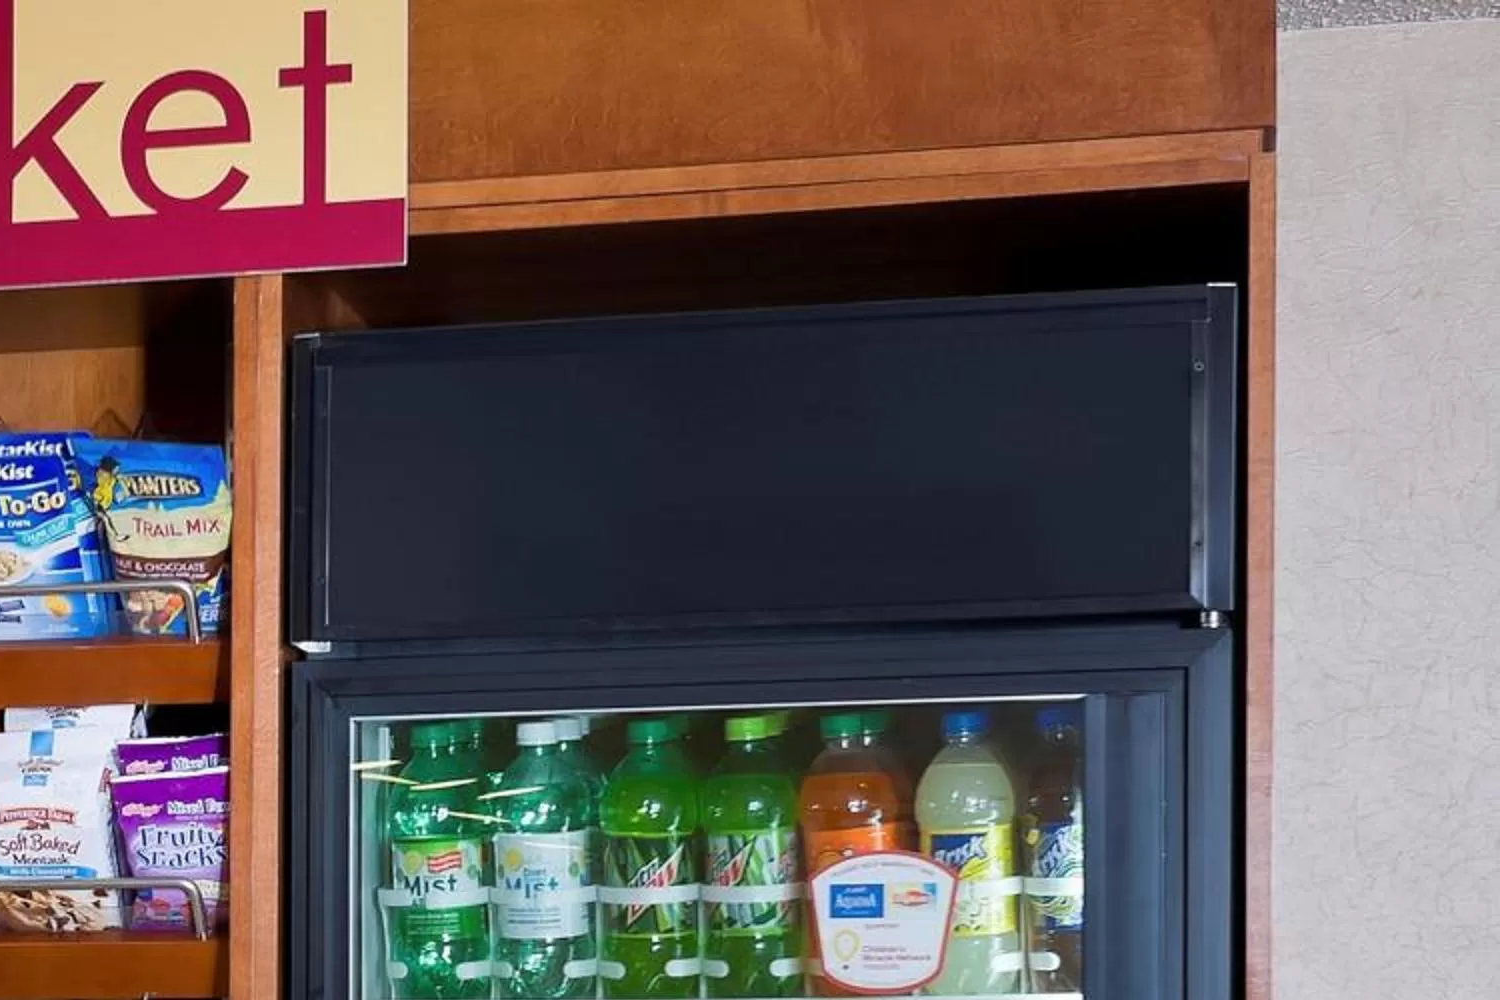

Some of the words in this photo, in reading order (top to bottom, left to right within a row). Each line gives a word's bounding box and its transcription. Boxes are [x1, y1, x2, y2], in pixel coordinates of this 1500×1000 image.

[7, 520, 32, 528] OWN
[132, 517, 182, 538] TRAIL
[185, 518, 222, 535] MIX
[144, 562, 208, 573] CHOCOLATE
[30, 834, 81, 855] Baked
[137, 823, 224, 848] Fruity
[136, 846, 227, 869] Snacks
